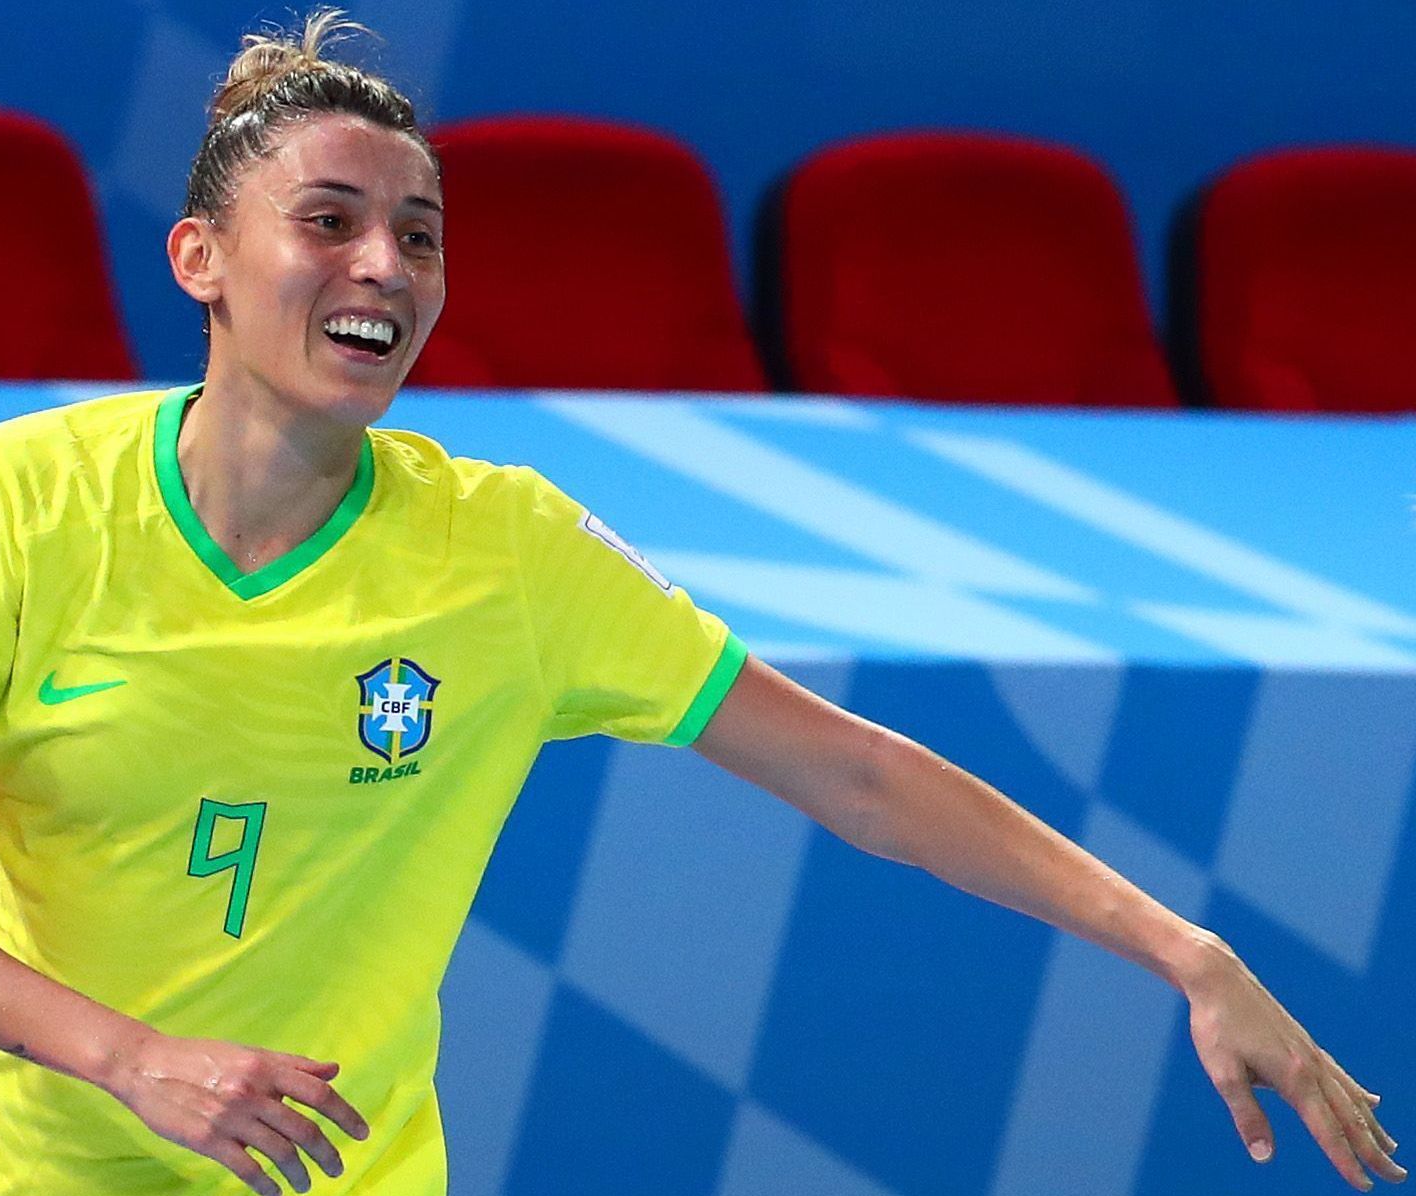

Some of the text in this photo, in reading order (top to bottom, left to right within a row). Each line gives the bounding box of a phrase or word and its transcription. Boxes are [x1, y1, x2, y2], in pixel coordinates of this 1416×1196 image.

[381, 701, 411, 714] CBF
[349, 761, 422, 784] BRASIL
[187, 797, 267, 939] 9
